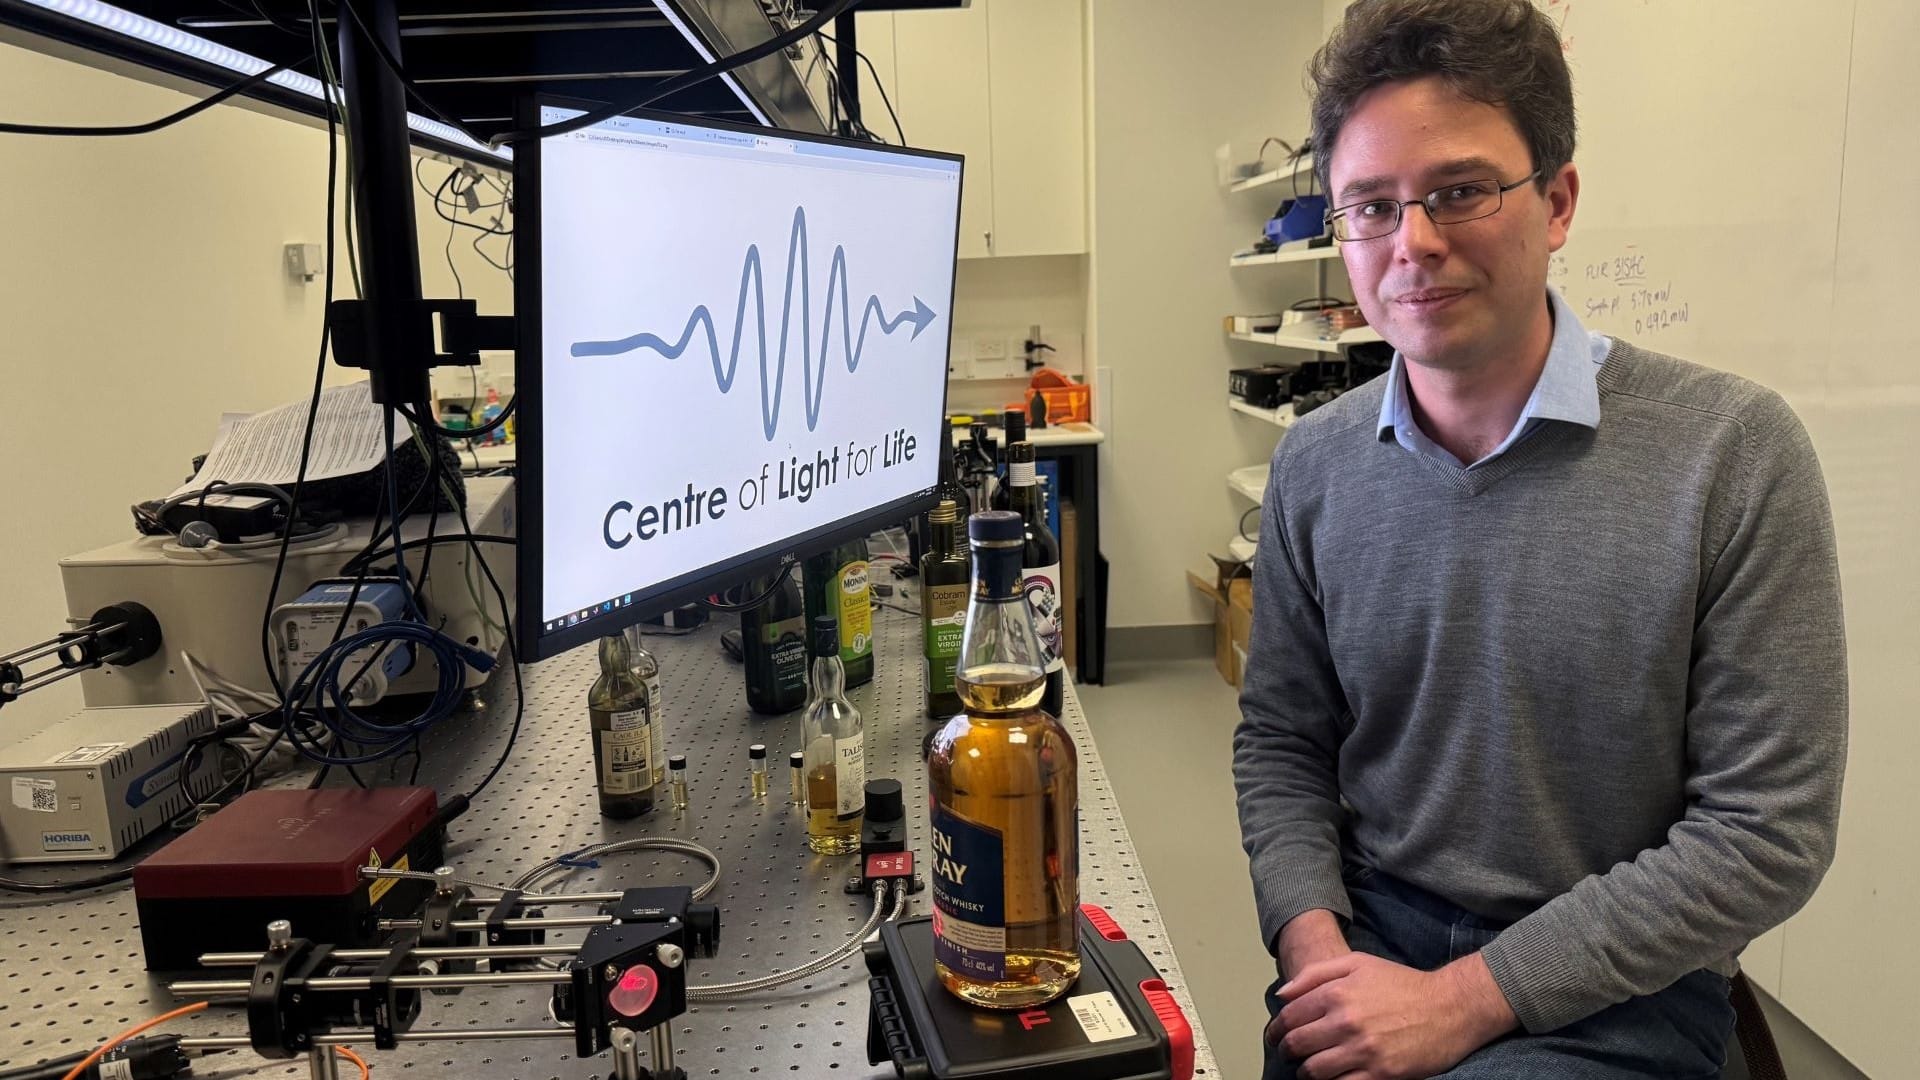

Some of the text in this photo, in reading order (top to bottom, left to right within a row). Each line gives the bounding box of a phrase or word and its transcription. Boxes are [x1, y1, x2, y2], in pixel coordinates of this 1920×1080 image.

[603, 428, 917, 550] Centre of Light for Life
[781, 552, 796, 565] DELL
[843, 575, 867, 589] MONINI
[932, 591, 966, 600] Cobram
[938, 633, 962, 642] EXTRA
[44, 834, 91, 843] HORIBA
[952, 897, 984, 912] WHISKY
